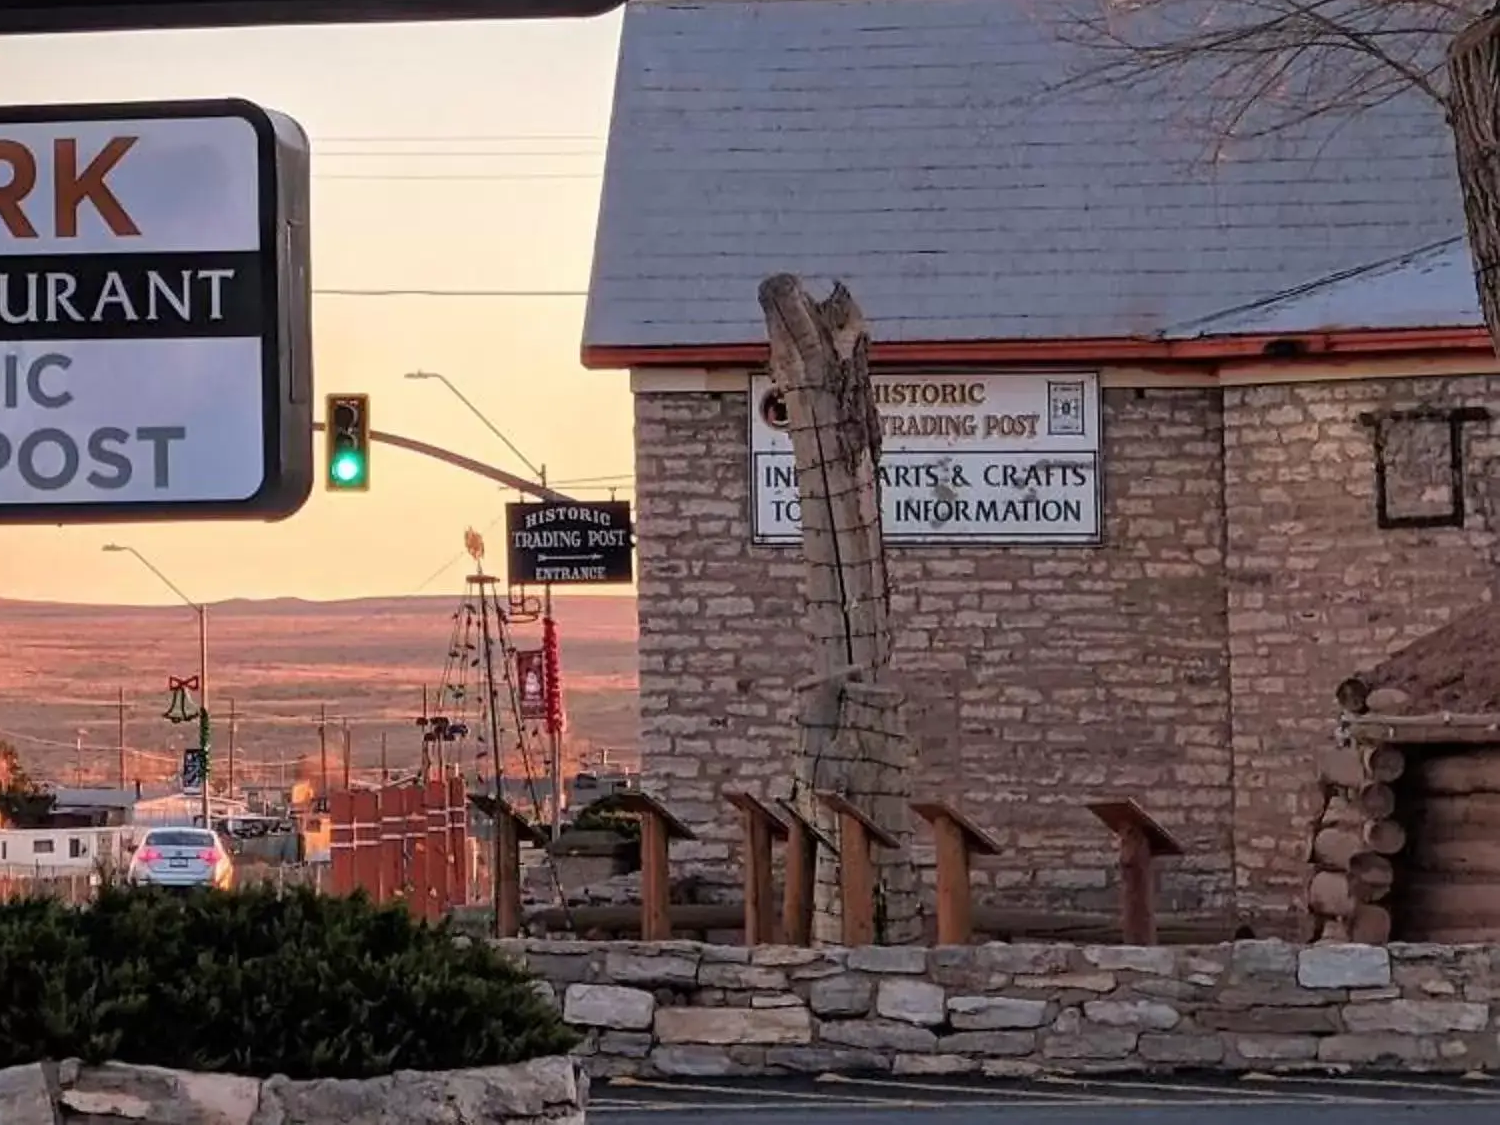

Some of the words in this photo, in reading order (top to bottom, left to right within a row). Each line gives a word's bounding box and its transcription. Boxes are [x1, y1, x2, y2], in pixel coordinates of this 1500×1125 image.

[984, 413, 1041, 438] POST
[950, 463, 972, 488] &
[982, 463, 1087, 487] CRAFTS
[524, 506, 612, 529] HISTORIC
[895, 499, 1082, 523] INFORMATION
[512, 529, 581, 549] TRADING
[586, 528, 626, 547] POST
[534, 565, 607, 581] ENTRANCE
